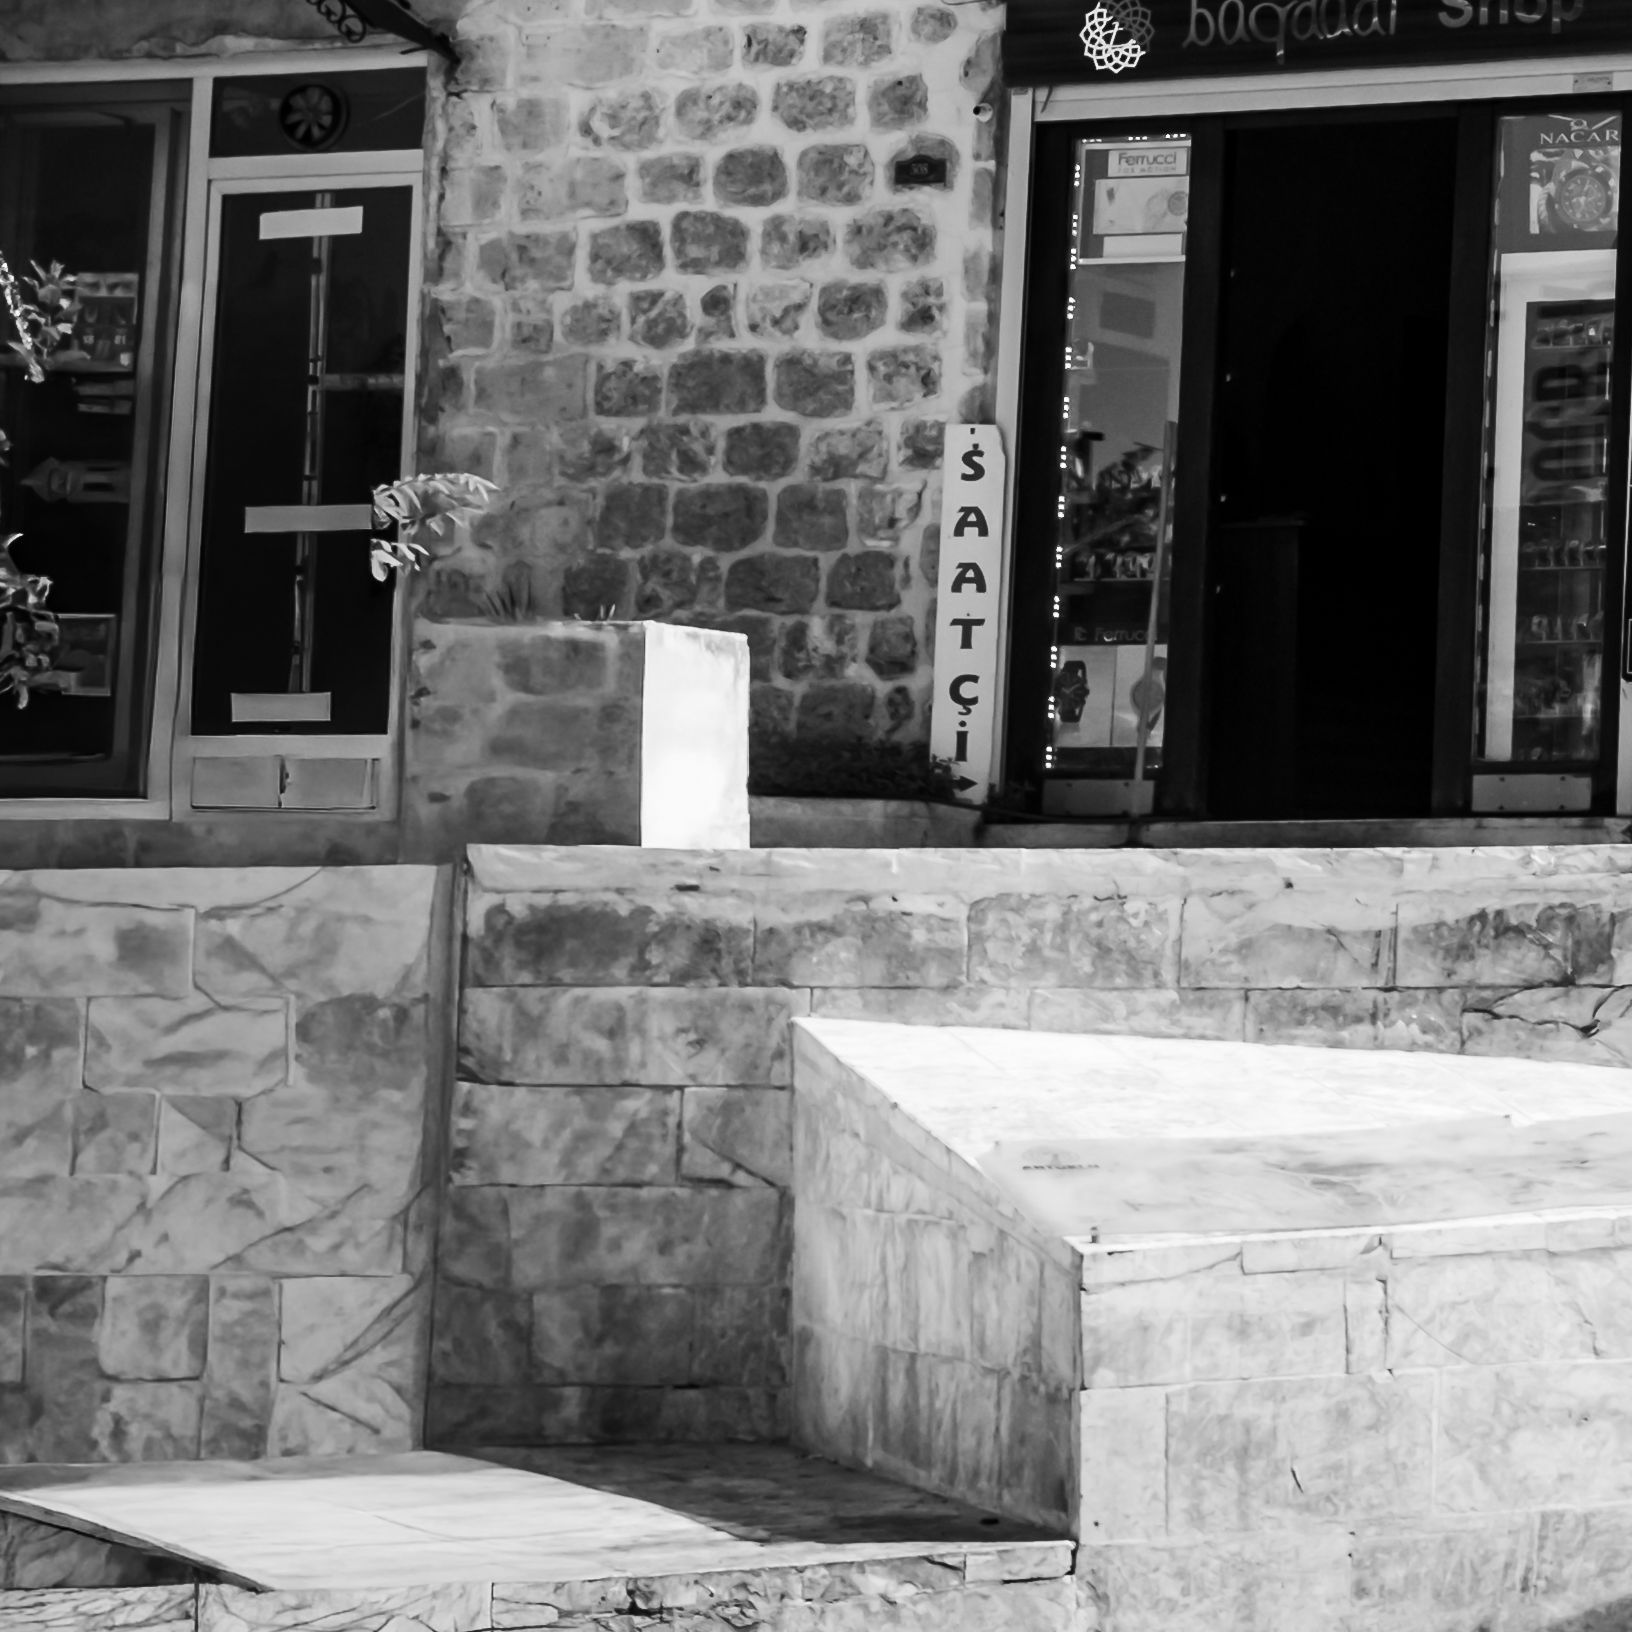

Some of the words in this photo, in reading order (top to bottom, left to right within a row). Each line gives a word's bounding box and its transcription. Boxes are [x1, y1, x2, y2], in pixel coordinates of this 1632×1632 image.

[1540, 129, 1619, 144] NACAR
[1118, 151, 1177, 167] Ferrucci
[948, 447, 989, 762] SAATÇİ
